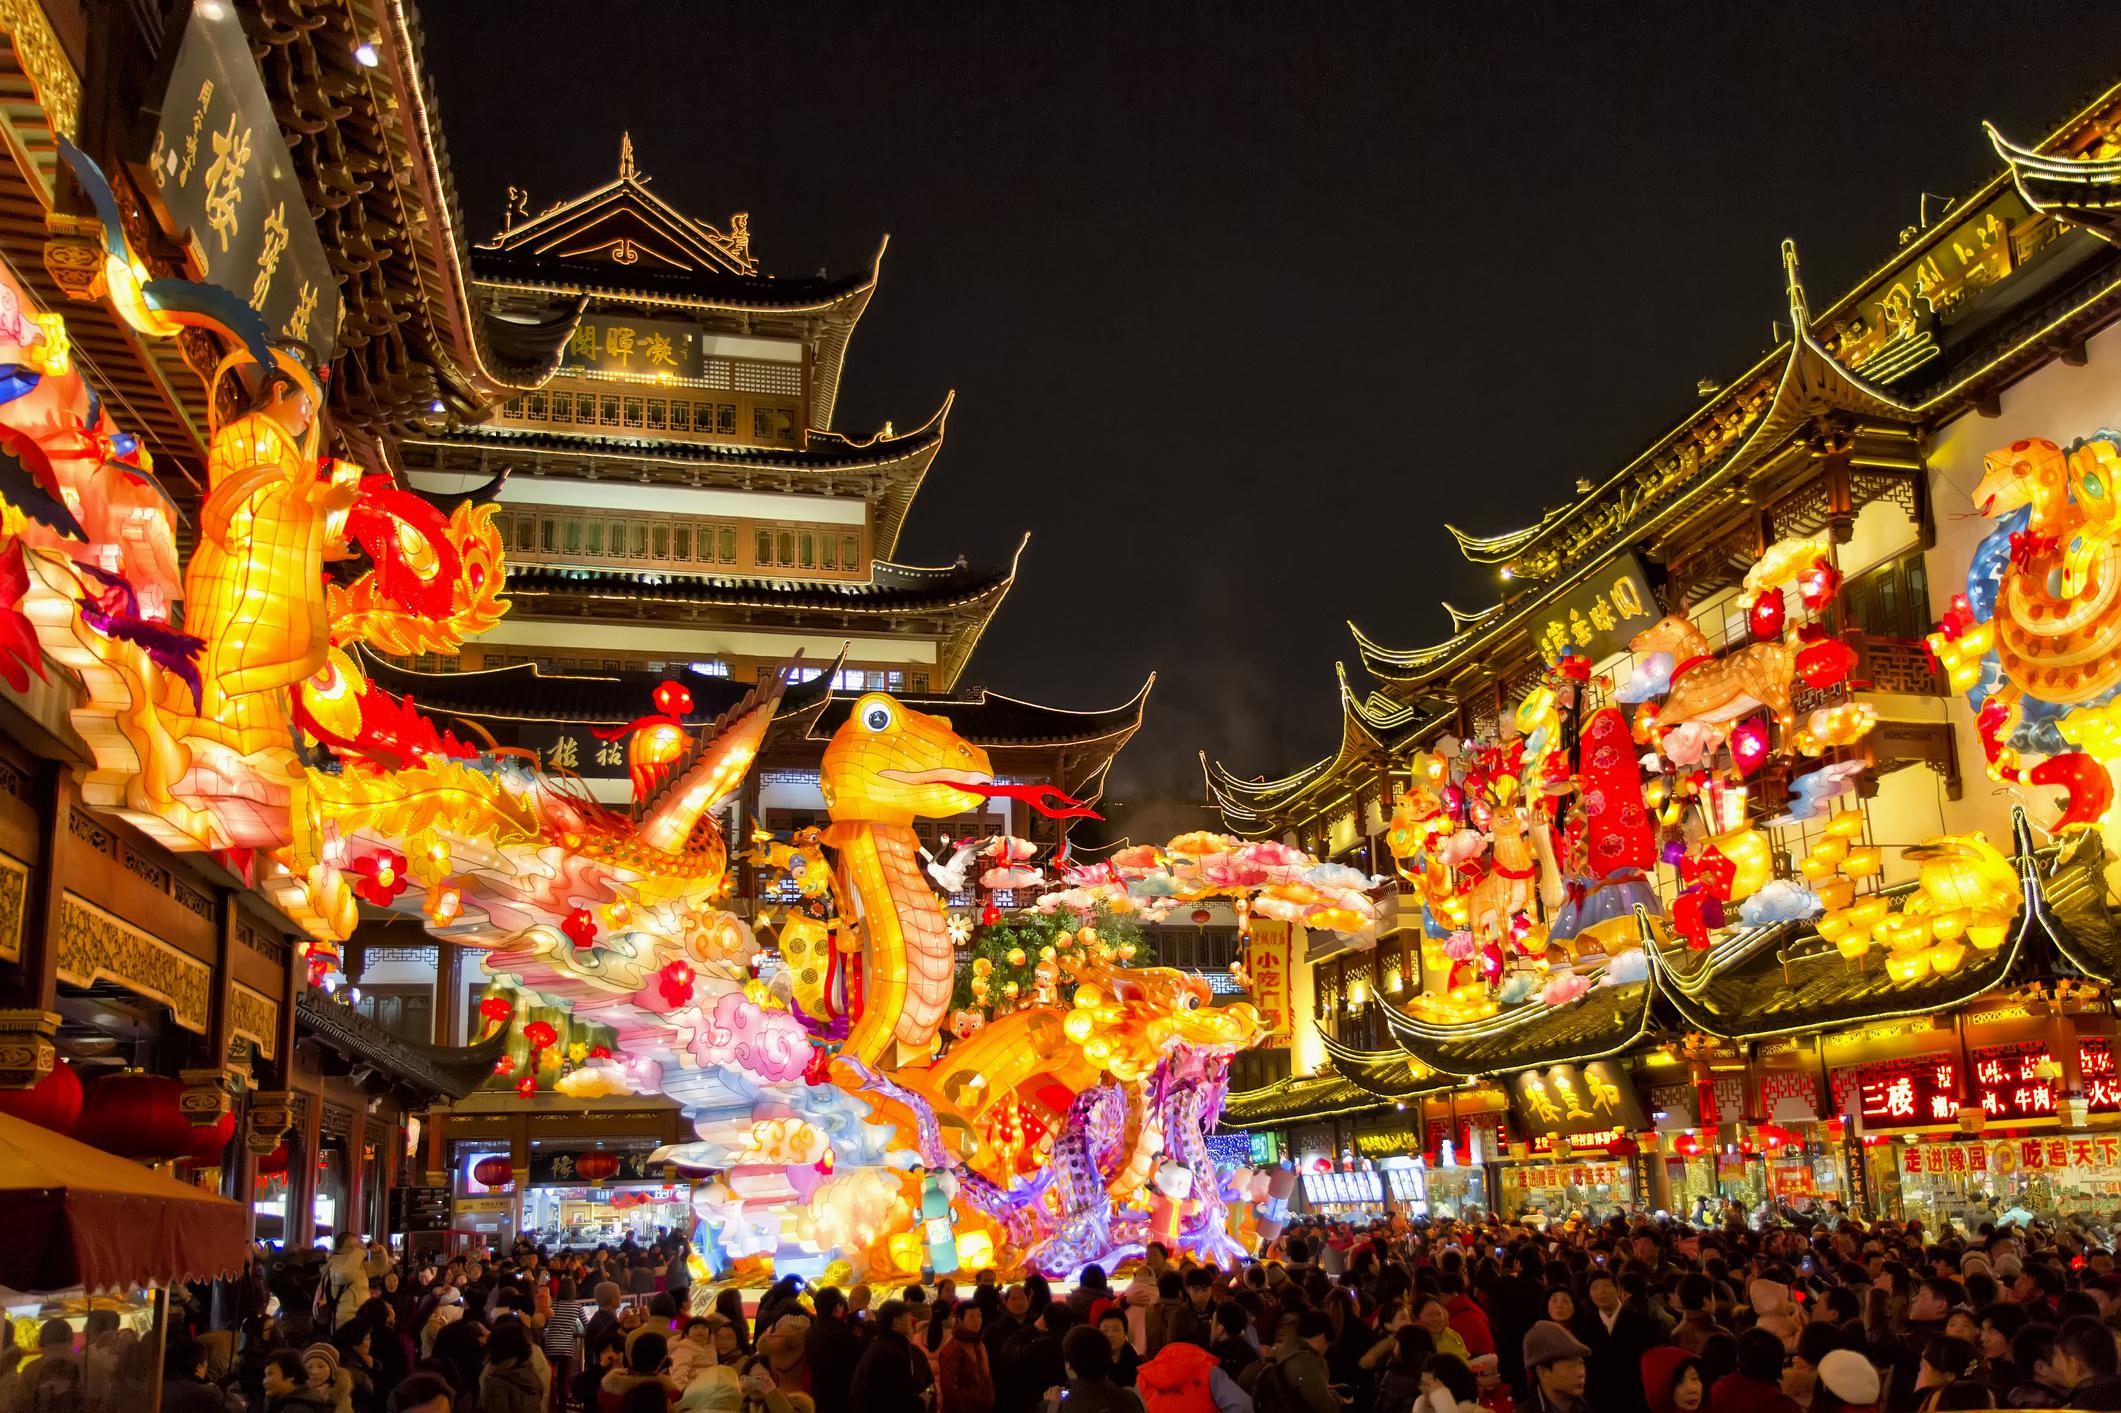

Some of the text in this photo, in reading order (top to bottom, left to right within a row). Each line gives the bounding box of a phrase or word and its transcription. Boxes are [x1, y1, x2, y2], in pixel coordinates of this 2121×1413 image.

[1862, 1077, 1914, 1117] 三楼
[1904, 1136, 2120, 1174] 走进豫园 吃遍天下
